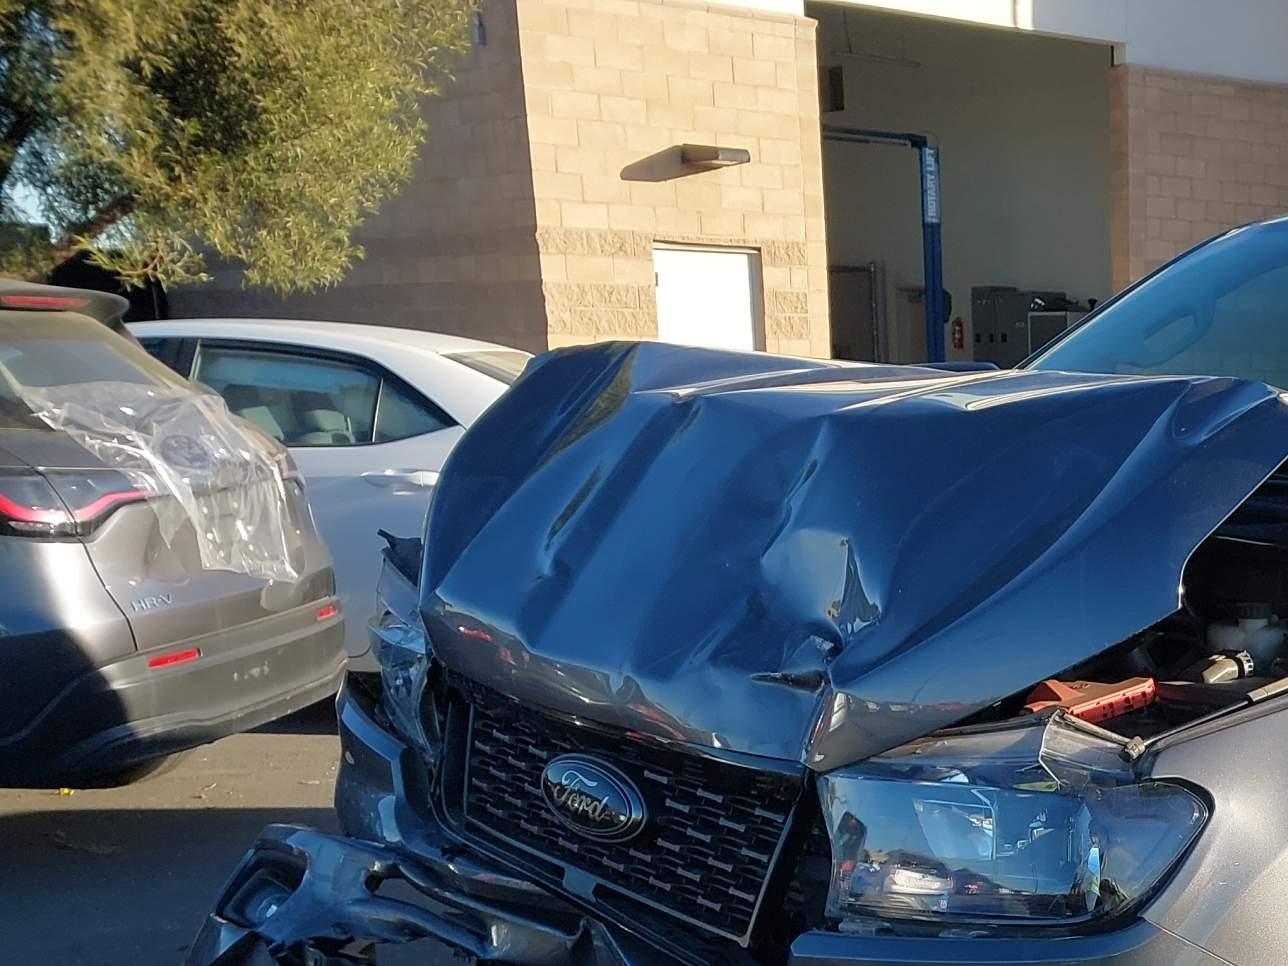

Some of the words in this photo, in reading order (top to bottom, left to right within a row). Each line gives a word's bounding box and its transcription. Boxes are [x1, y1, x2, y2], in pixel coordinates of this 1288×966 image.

[926, 148, 935, 171] LIFT
[926, 174, 937, 217] ROTARY
[131, 593, 172, 612] HR-V
[553, 769, 609, 821] Ford
